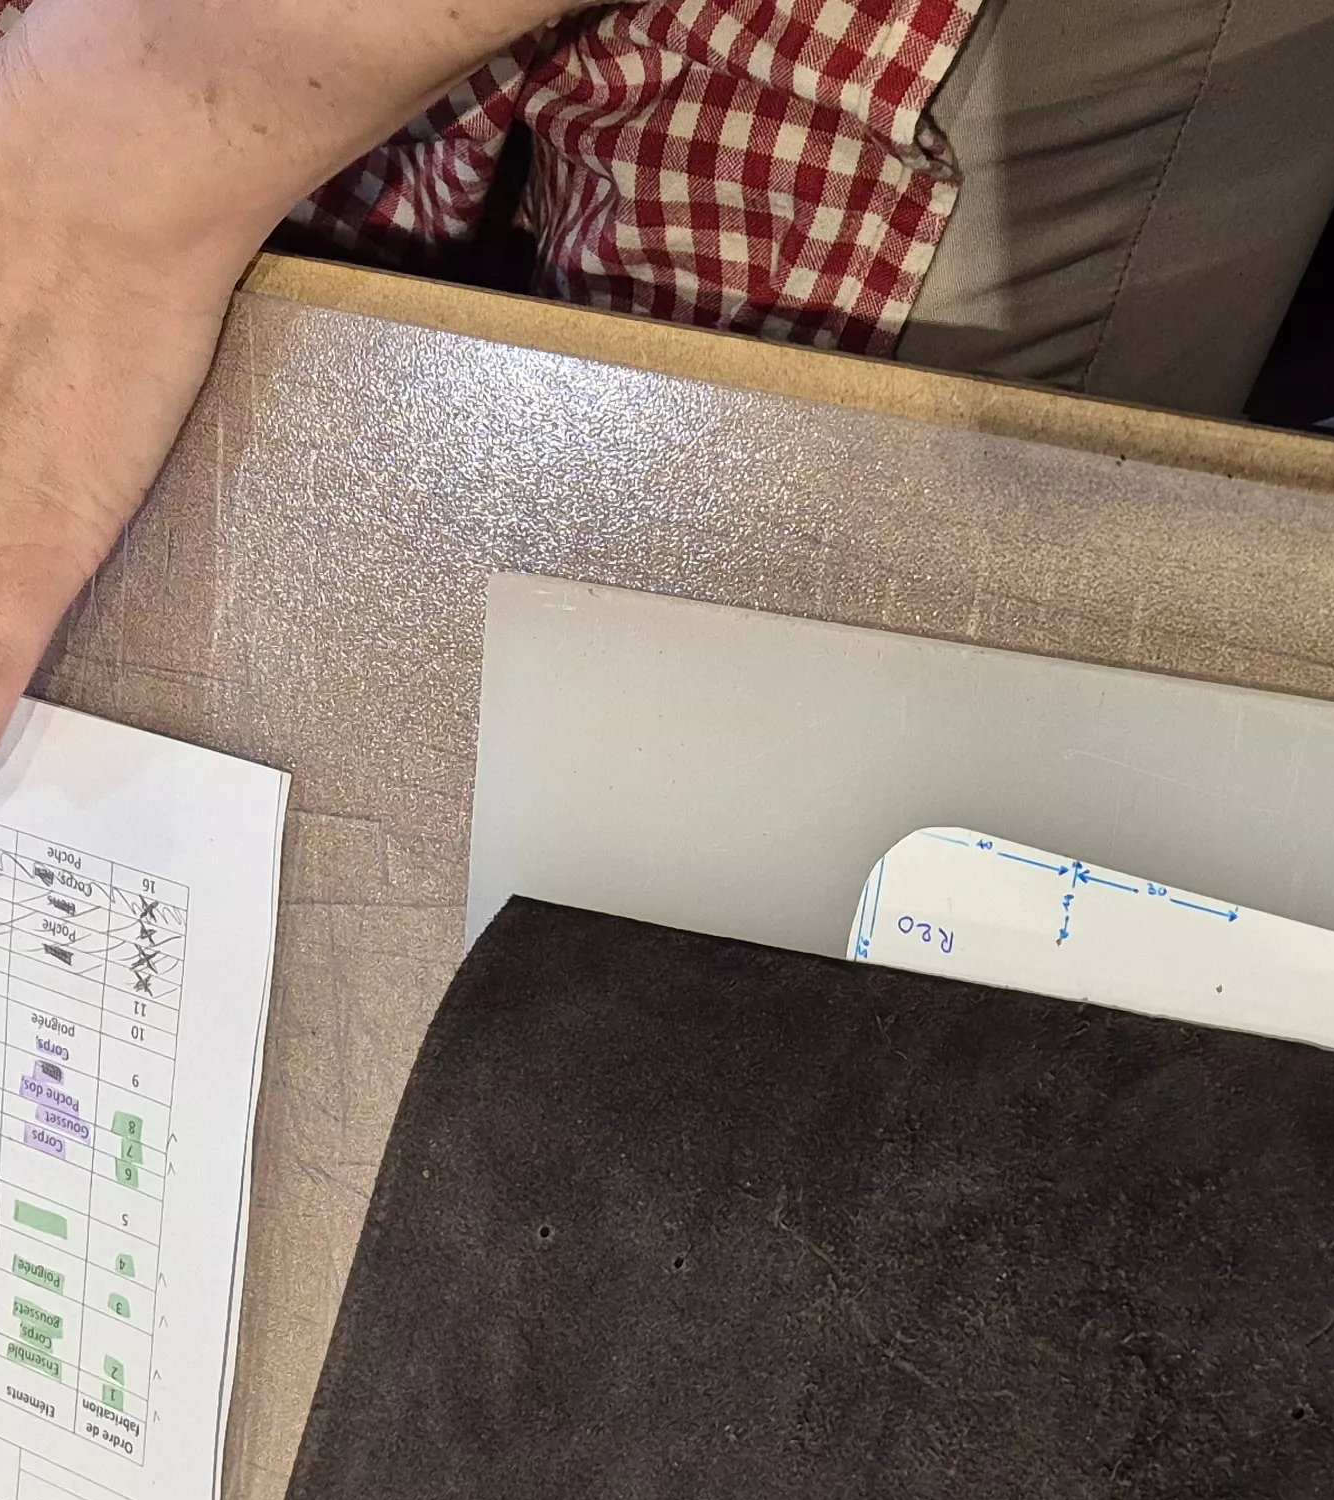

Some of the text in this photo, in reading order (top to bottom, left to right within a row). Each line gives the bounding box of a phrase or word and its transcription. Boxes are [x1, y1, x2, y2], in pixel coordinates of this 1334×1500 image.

[46, 846, 82, 871] Poche
[141, 877, 157, 895] 16
[896, 913, 957, 956] R20
[133, 999, 148, 1018] 11
[30, 1011, 76, 1038] poignée
[130, 1024, 146, 1042] 10
[34, 1034, 70, 1062] Corps,
[131, 1073, 140, 1089] 9
[18, 1074, 80, 1114] Poche dos,
[44, 1110, 90, 1140] Gousset
[127, 1120, 137, 1136] 8
[30, 1128, 64, 1154] Corps
[125, 1143, 134, 1159] 7
[124, 1166, 133, 1182] 6
[121, 1212, 130, 1228] 5
[16, 1258, 61, 1289] Poignée
[118, 1257, 127, 1272] 4
[12, 1300, 62, 1330] goussets
[115, 1300, 124, 1312] 3
[19, 1321, 53, 1351] Corps,
[6, 1342, 60, 1375] Ensemble
[110, 1365, 119, 1379] 2
[6, 1385, 56, 1419] Eléments
[109, 1387, 118, 1403] 1
[81, 1398, 141, 1438] fabrication
[85, 1421, 134, 1455] Ordre de
